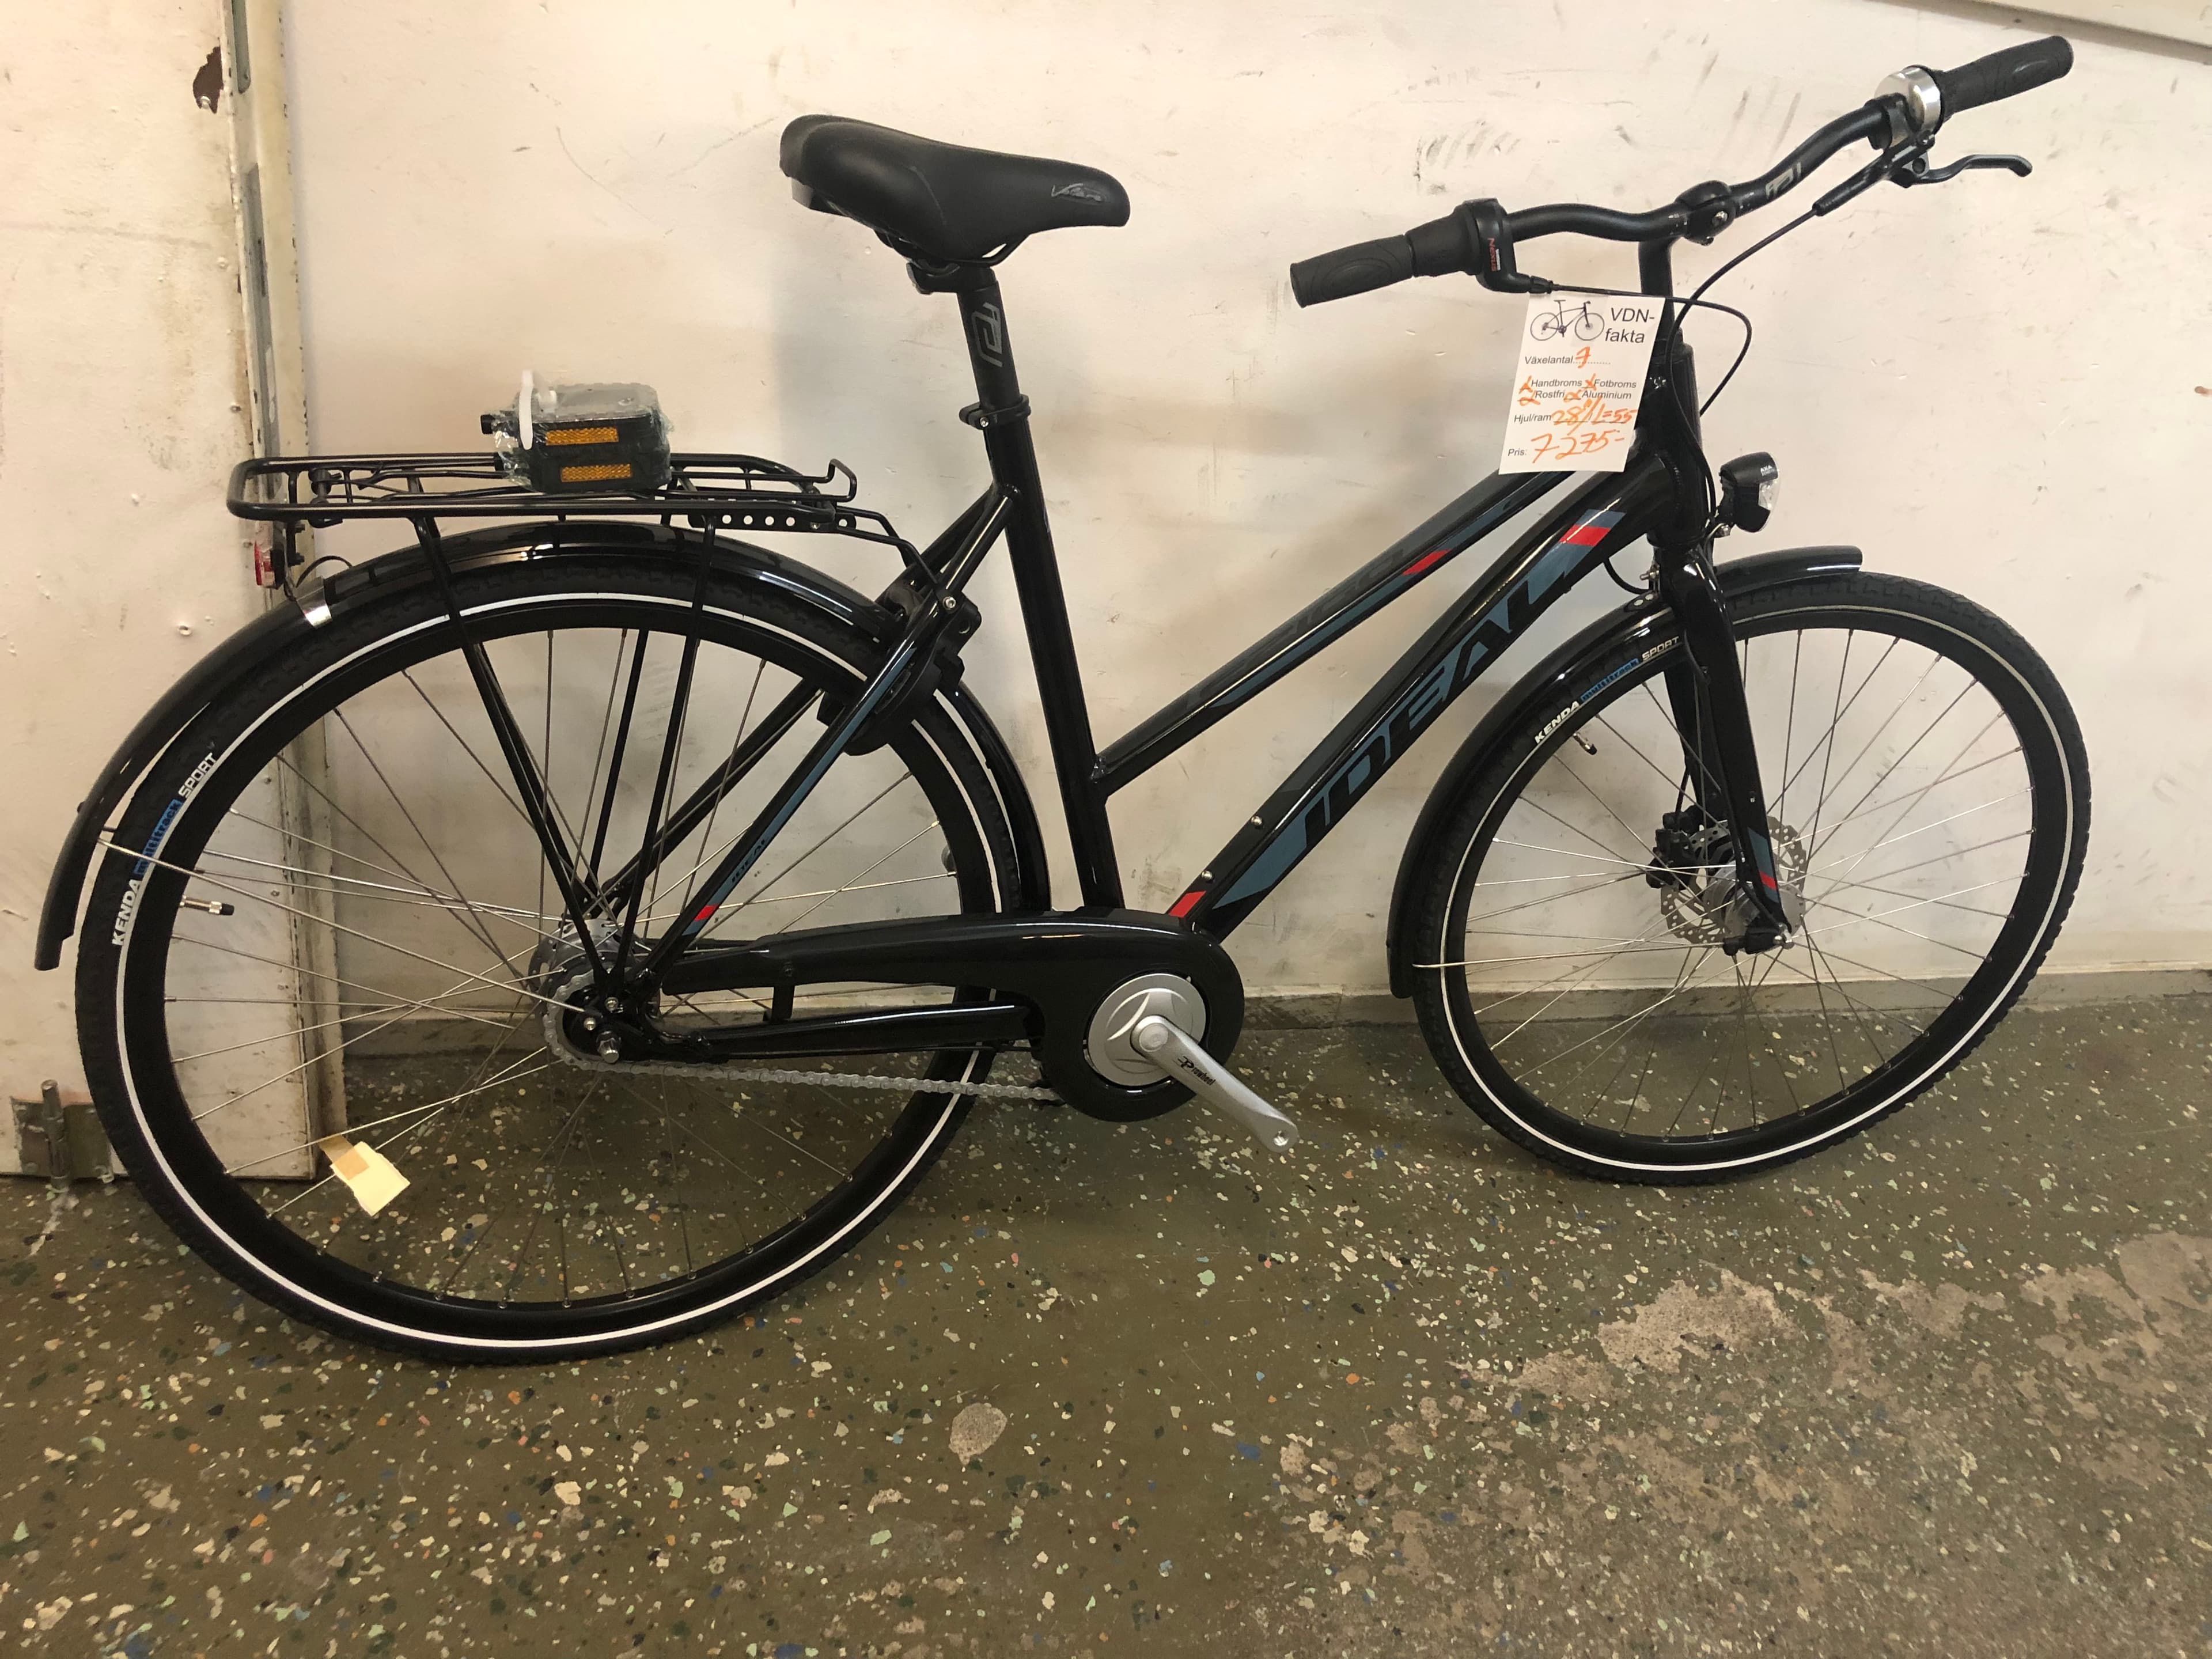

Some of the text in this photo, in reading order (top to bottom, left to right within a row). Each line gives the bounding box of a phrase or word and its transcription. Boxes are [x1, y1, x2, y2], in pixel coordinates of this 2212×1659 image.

[1611, 307, 1655, 323] VDN-
[1604, 328, 1645, 343] fakta
[1525, 355, 1574, 365] Växelantal
[1531, 378, 1637, 388] Handbroms Fotbroms
[1535, 390, 1632, 400] Rostfri Aluminium
[1514, 414, 1552, 423] Hjul/ram
[1534, 700, 1581, 744] KENDA
[1642, 635, 1679, 661] SPORT
[112, 878, 142, 946] KENDA
[179, 752, 217, 798] SPORT
